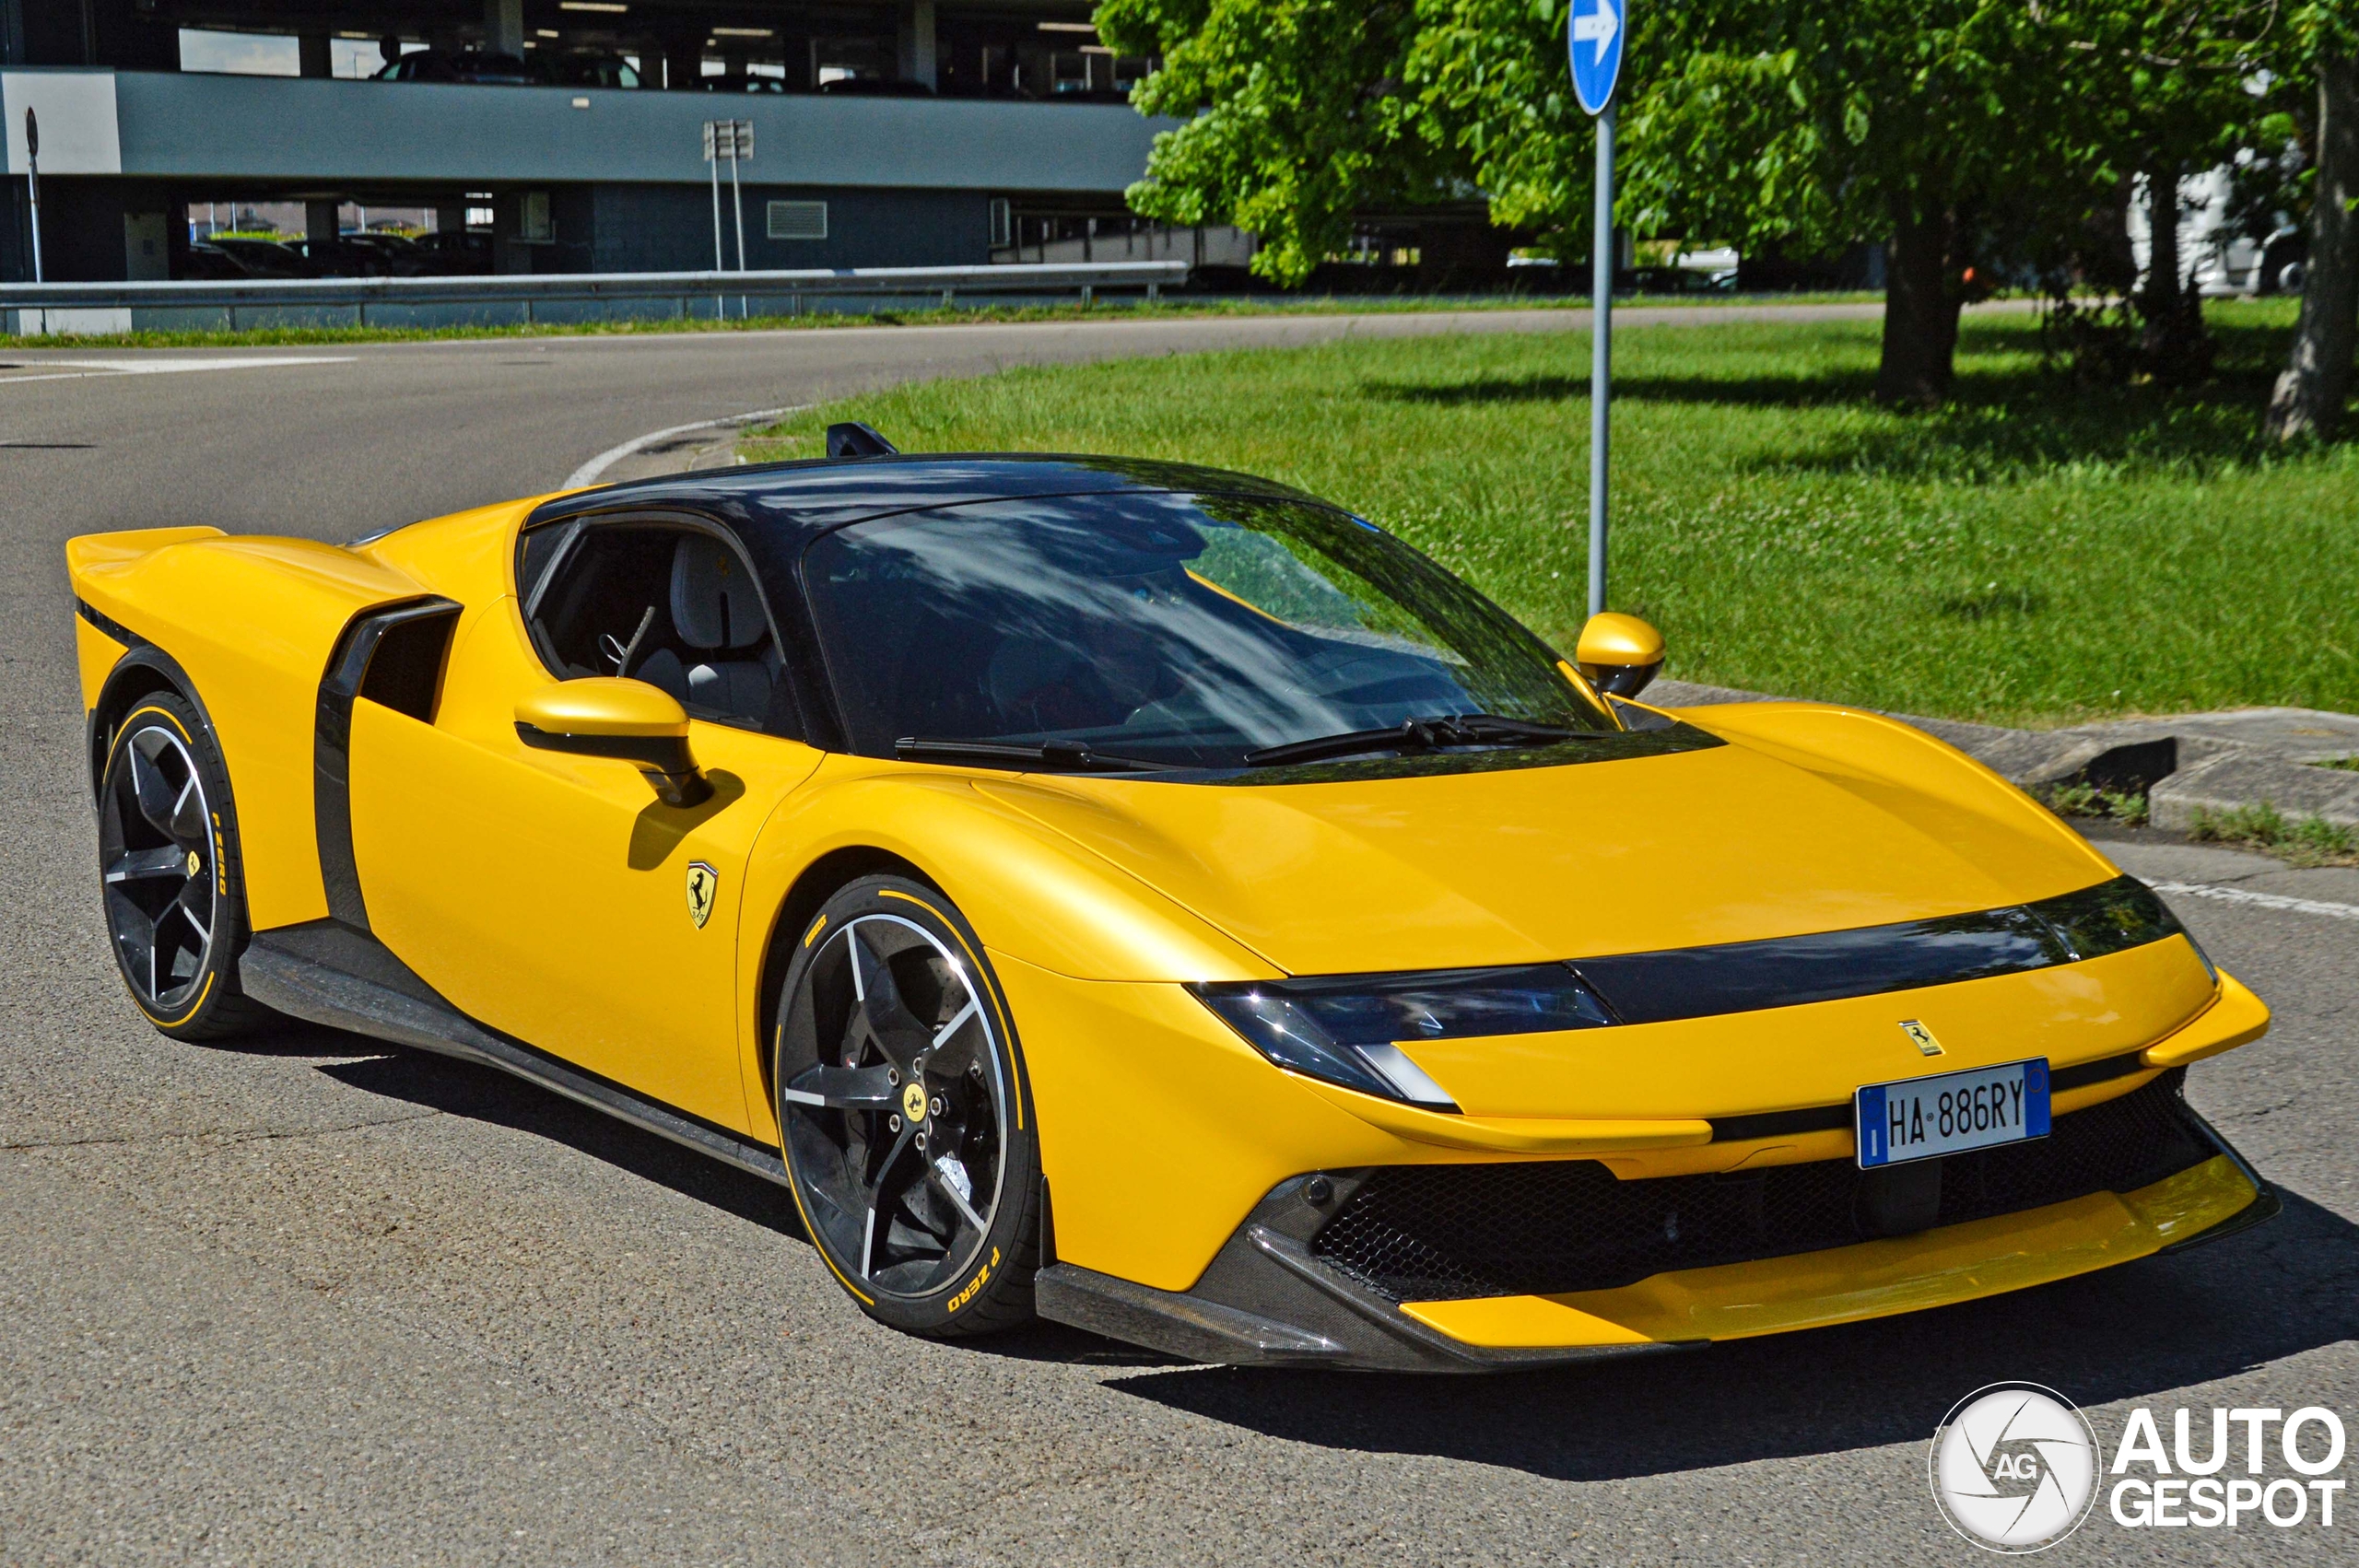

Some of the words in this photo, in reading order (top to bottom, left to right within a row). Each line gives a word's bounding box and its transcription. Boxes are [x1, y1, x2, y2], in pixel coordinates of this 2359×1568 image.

[215, 831, 227, 895] ZERO
[1890, 1097, 1925, 1147] HA
[1939, 1079, 2024, 1138] 886RY
[991, 1246, 1001, 1268] P
[947, 1264, 991, 1313] ZERO
